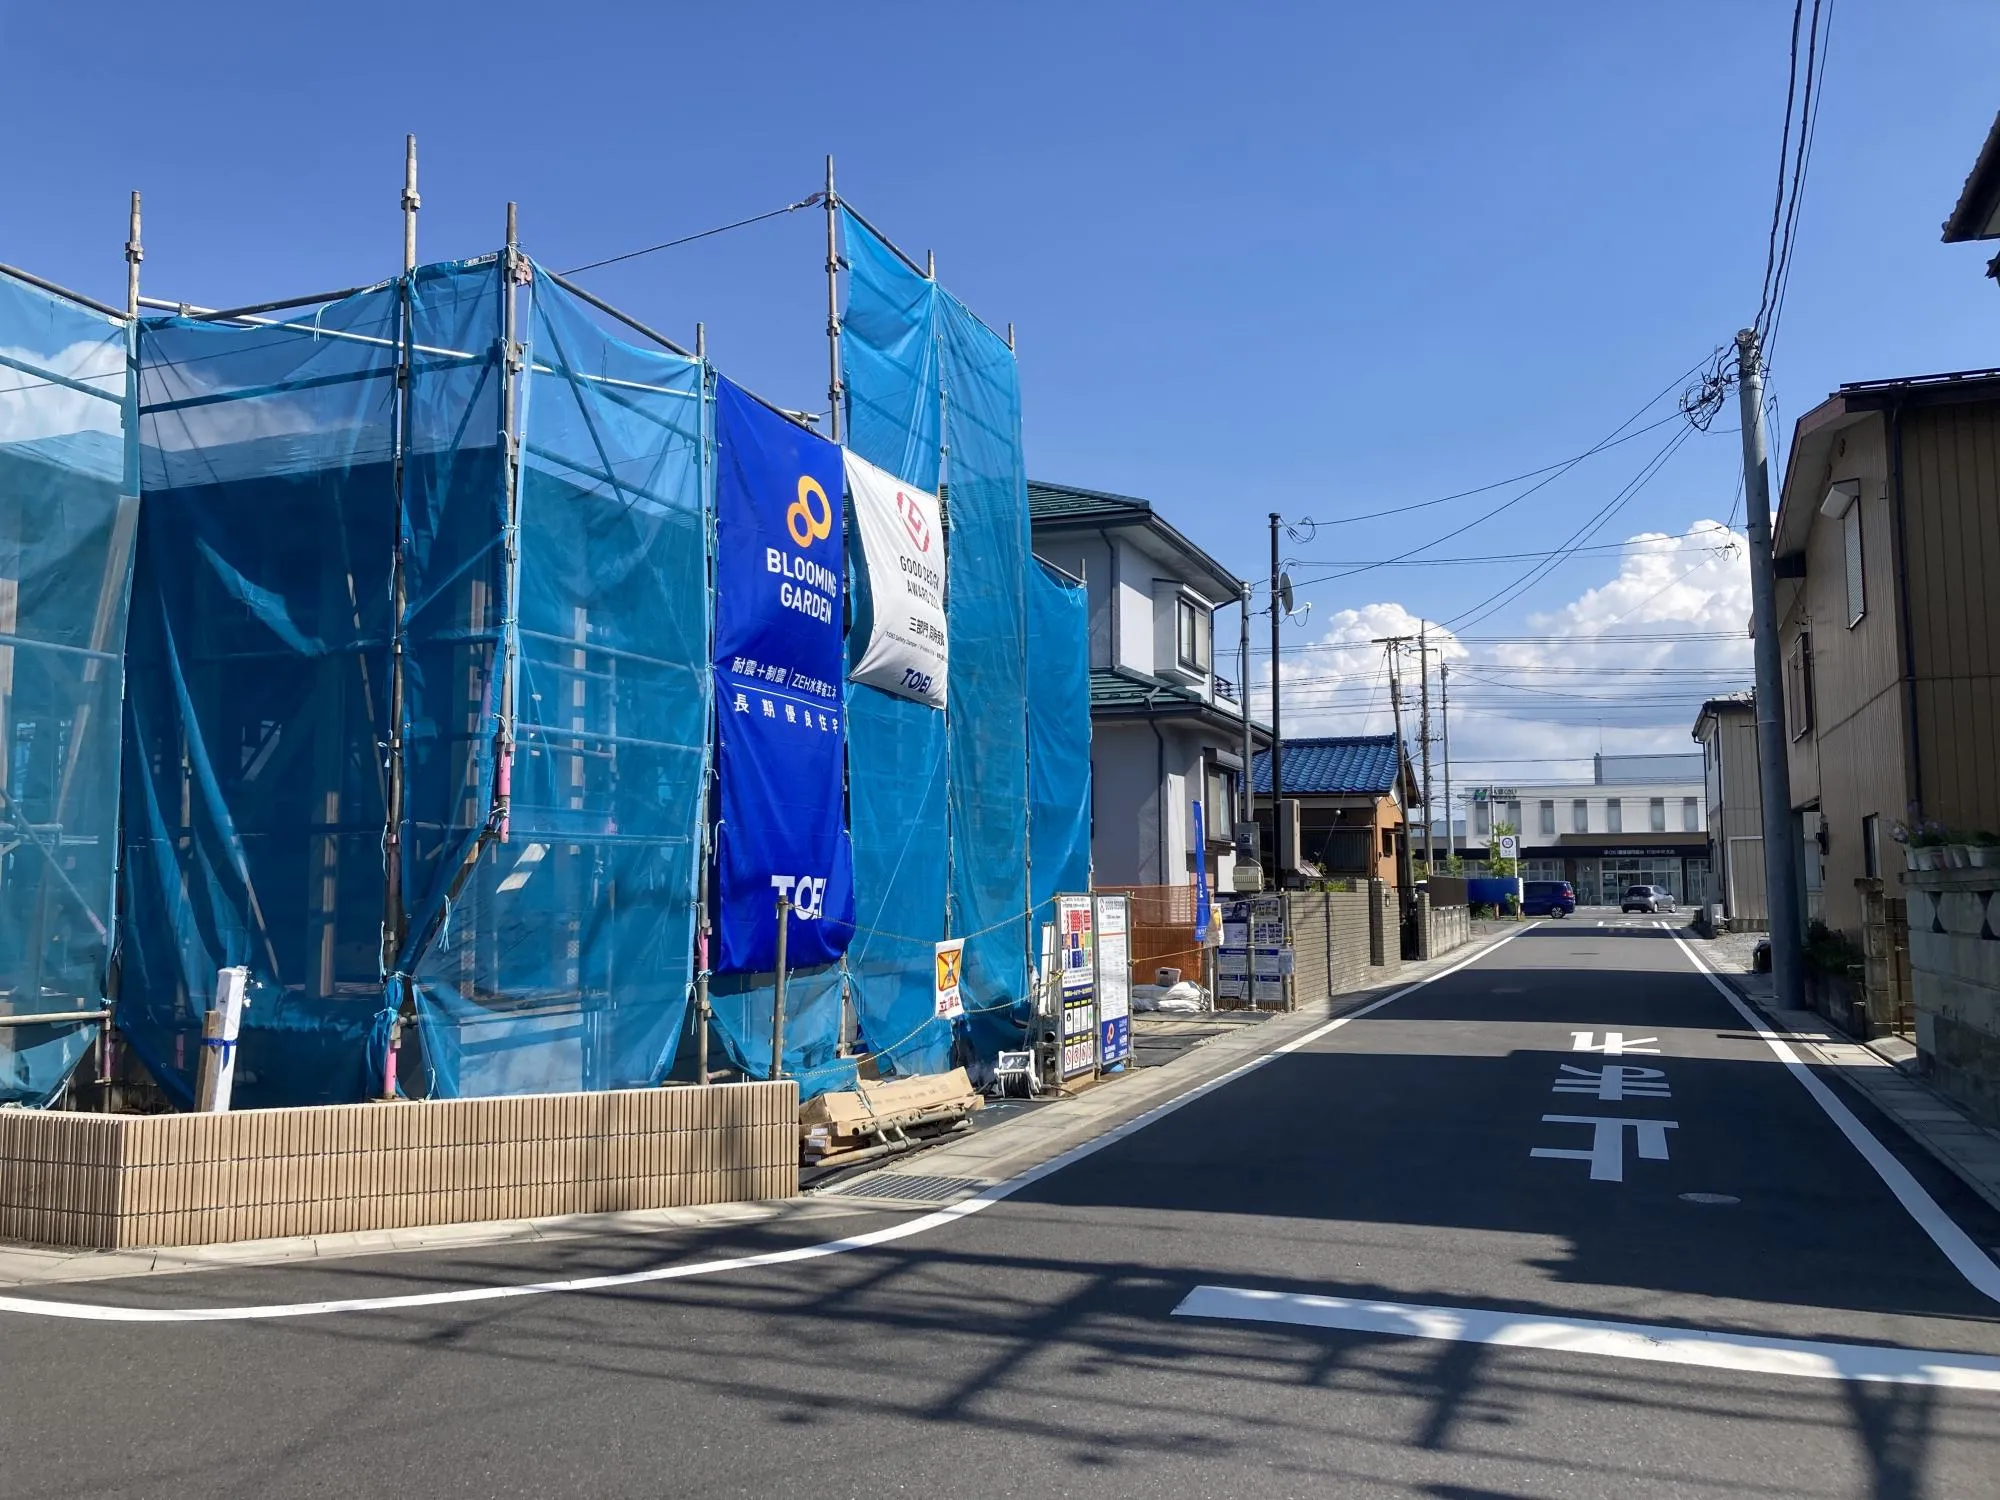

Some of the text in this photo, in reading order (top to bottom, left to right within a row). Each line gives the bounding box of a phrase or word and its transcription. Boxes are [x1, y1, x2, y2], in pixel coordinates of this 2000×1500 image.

[766, 547, 837, 599] BLOOMING
[900, 555, 922, 578] GOOD
[780, 582, 832, 625] GARDEN
[900, 668, 933, 694] TOEI
